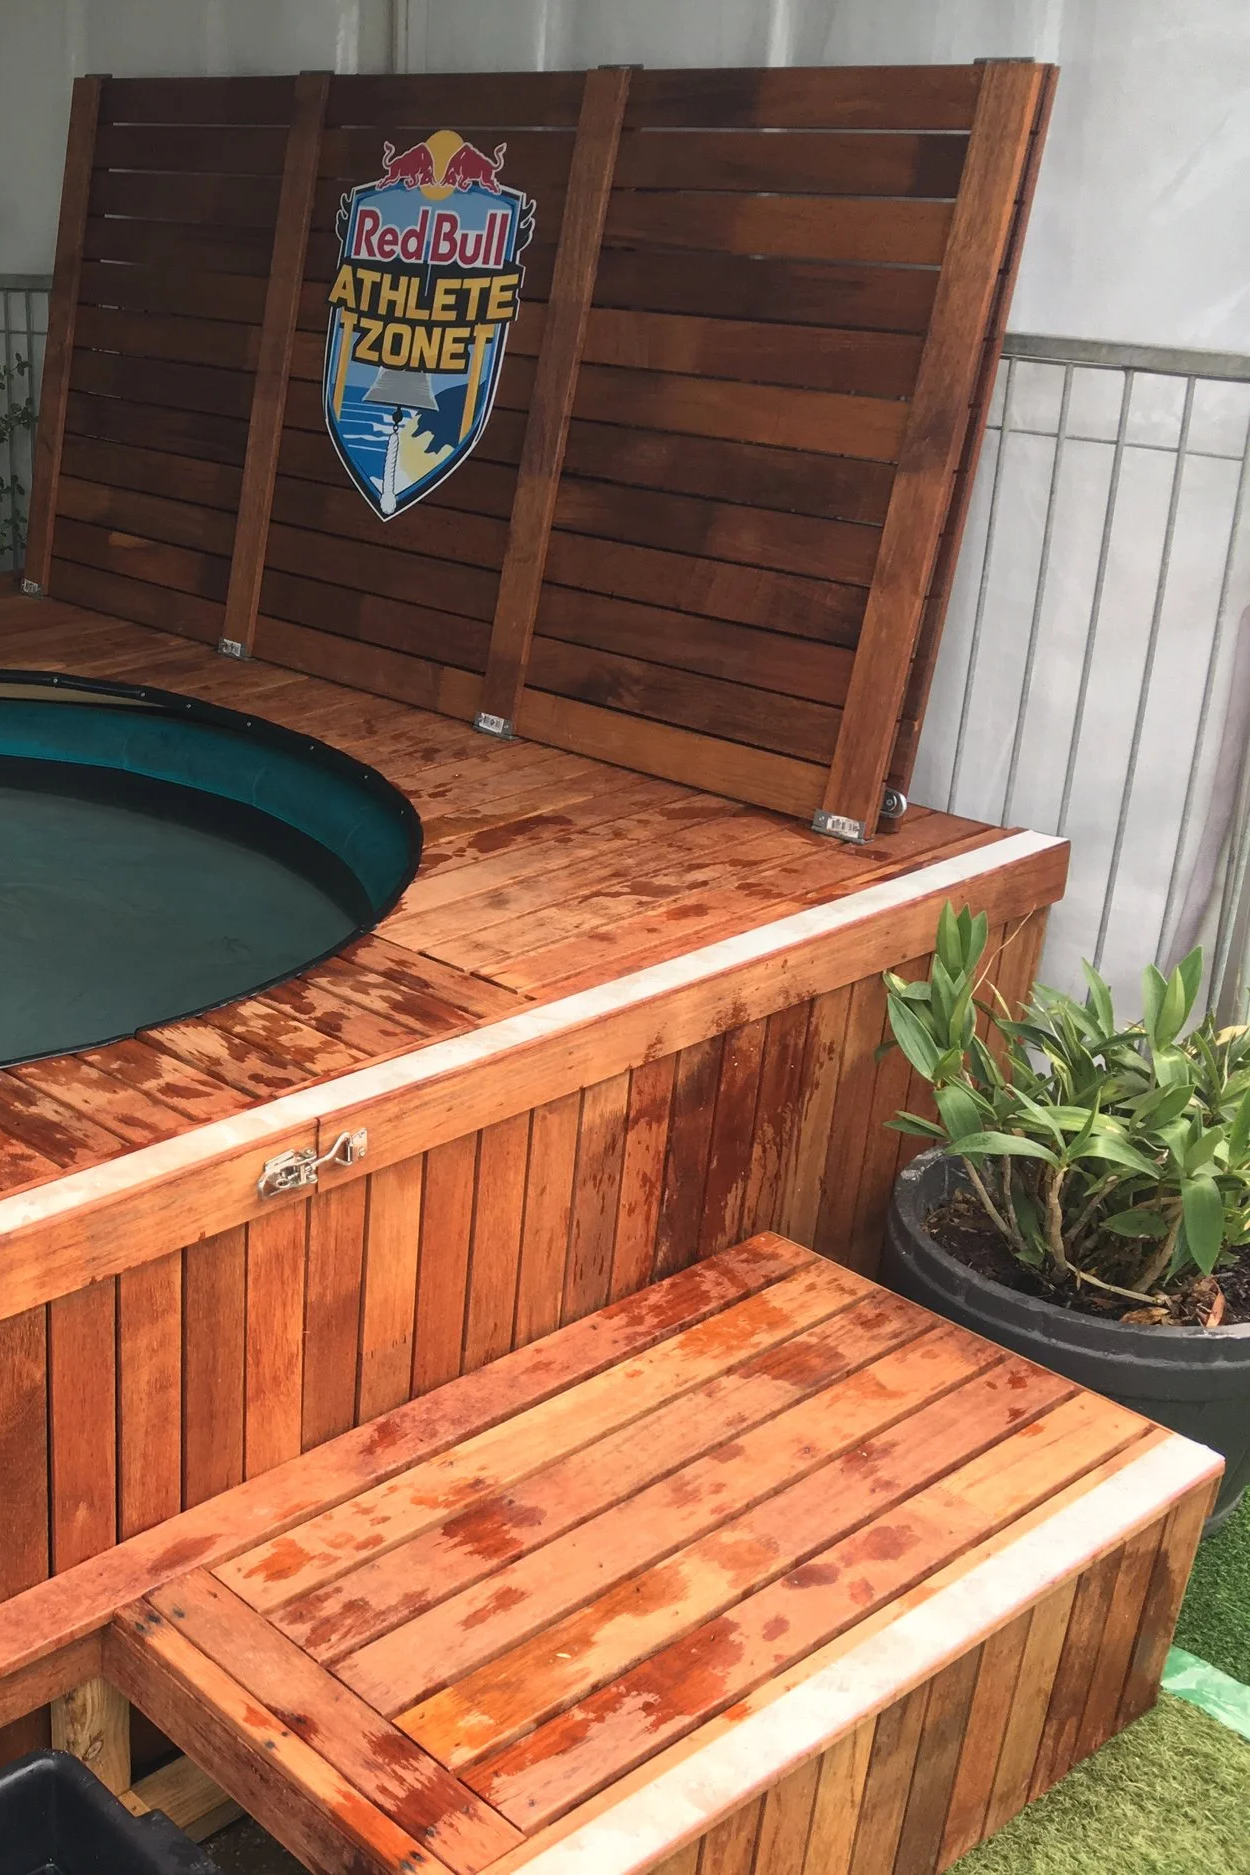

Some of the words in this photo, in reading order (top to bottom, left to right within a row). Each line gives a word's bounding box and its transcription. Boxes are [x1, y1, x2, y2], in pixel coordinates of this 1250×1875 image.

[352, 206, 430, 261] Red
[431, 210, 509, 267] Bull
[328, 264, 519, 321] ATHLETE
[355, 318, 469, 370] ZONE
